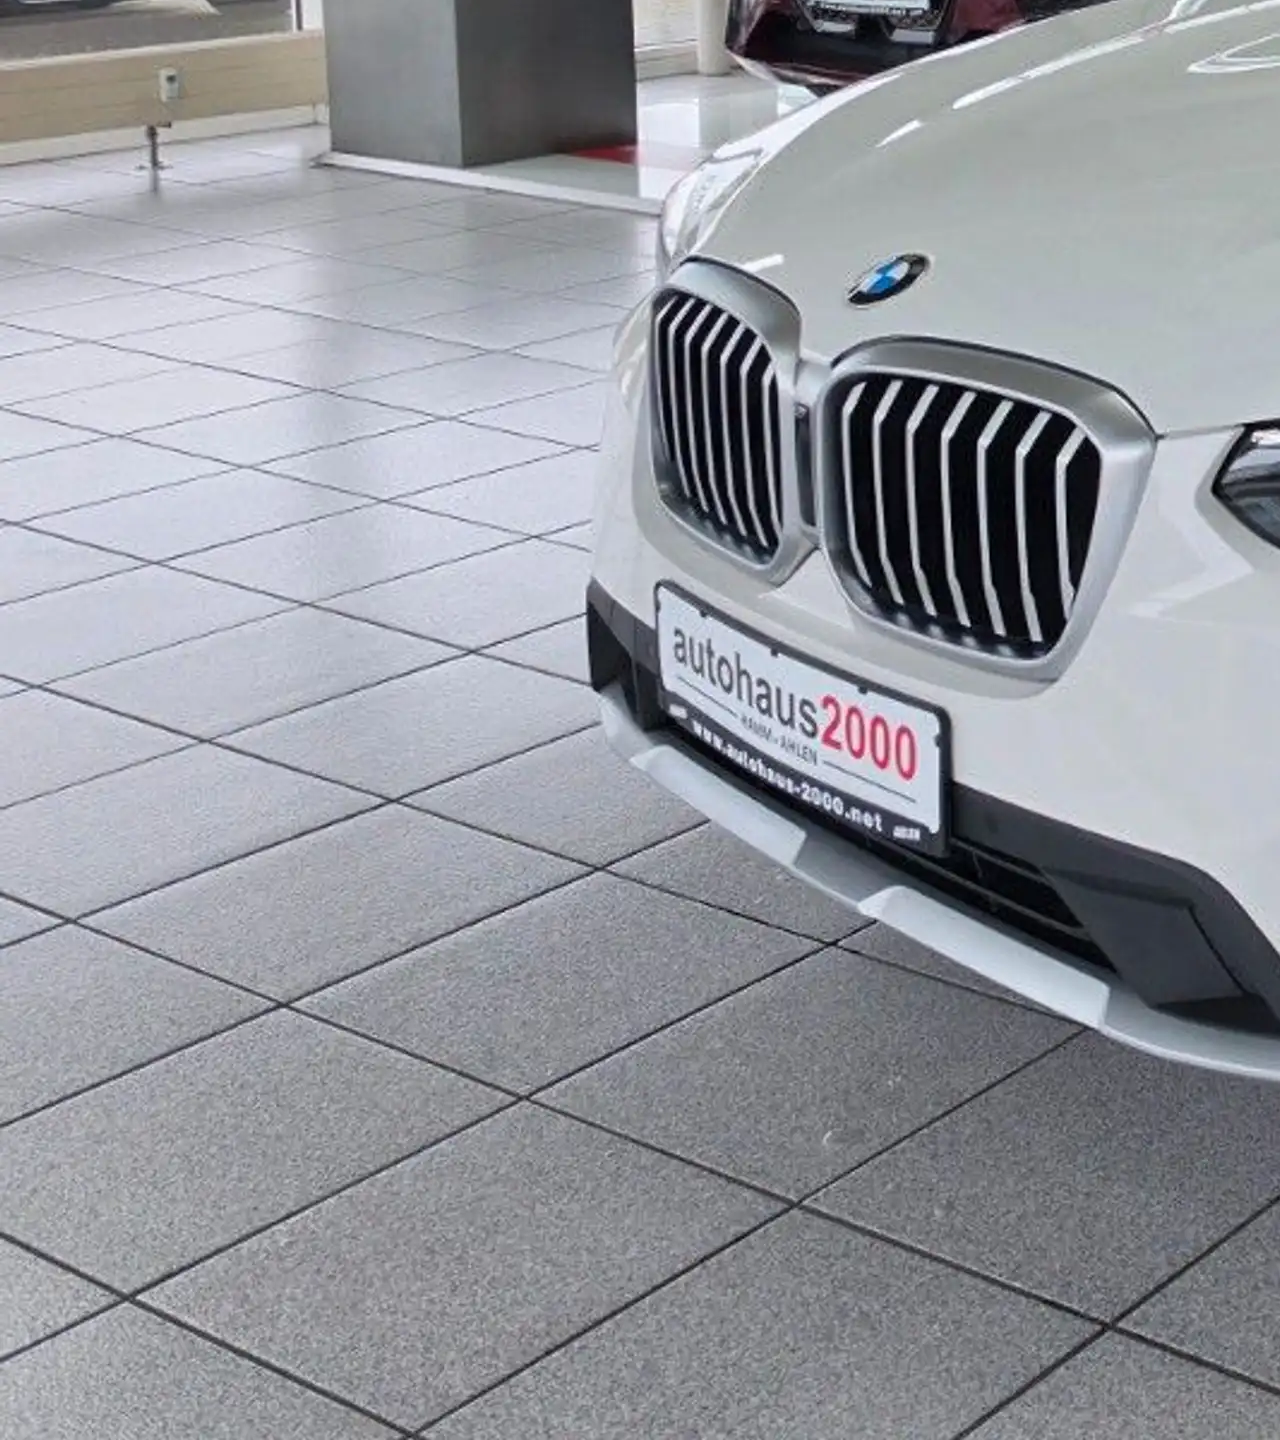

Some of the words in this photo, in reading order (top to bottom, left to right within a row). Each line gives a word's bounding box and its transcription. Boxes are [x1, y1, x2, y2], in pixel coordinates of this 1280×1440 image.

[673, 626, 917, 781] autohaus2000
[780, 735, 818, 766] AHLEN
[692, 718, 883, 833] www.autohaus-2000.net
